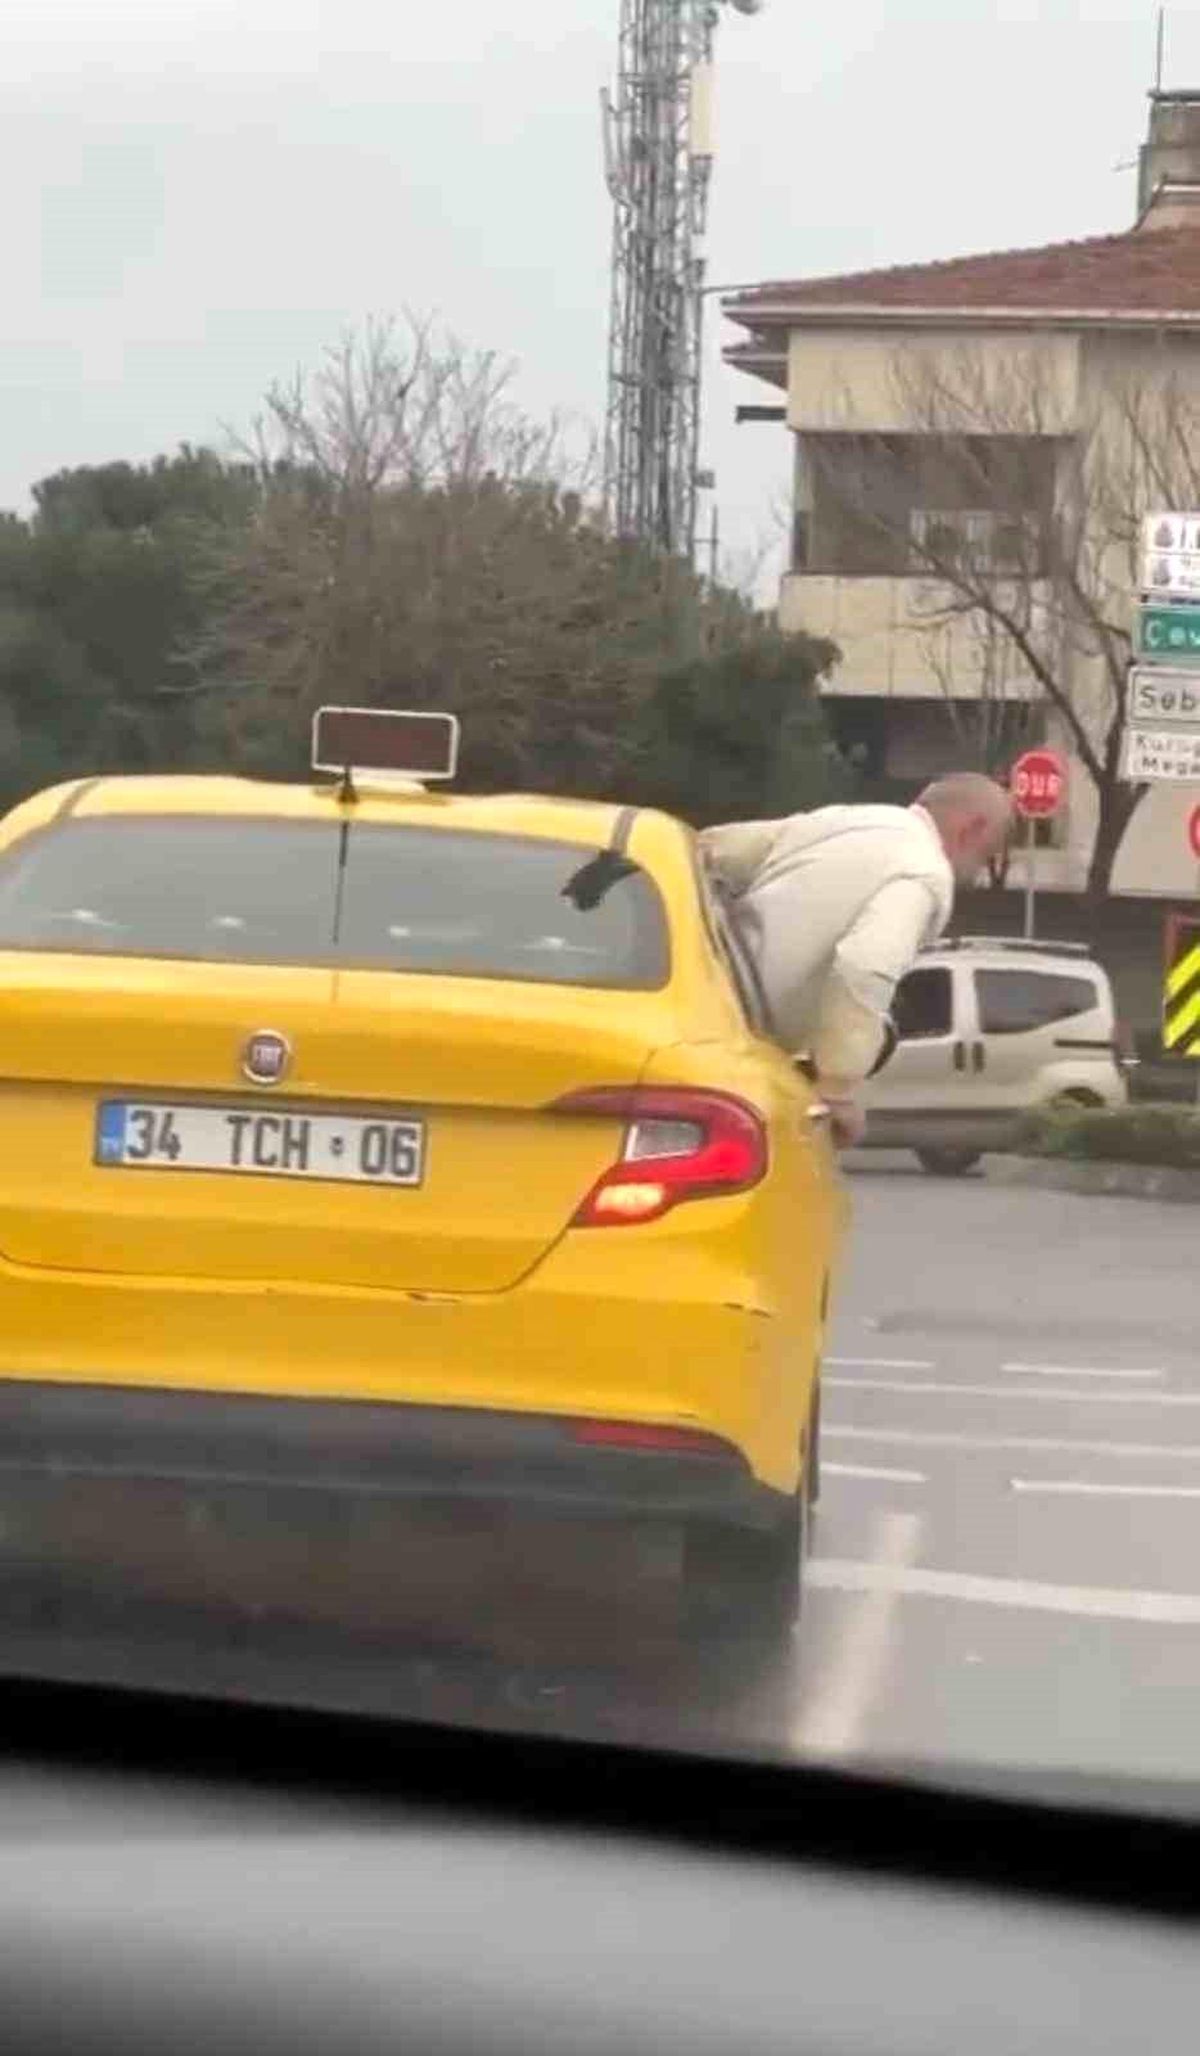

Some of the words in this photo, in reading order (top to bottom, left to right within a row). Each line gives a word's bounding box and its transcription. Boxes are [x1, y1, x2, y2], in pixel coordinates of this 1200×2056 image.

[1017, 771, 1062, 797] DUR
[128, 1109, 182, 1160] 34
[226, 1115, 311, 1170] TCH
[361, 1124, 417, 1178] 06
